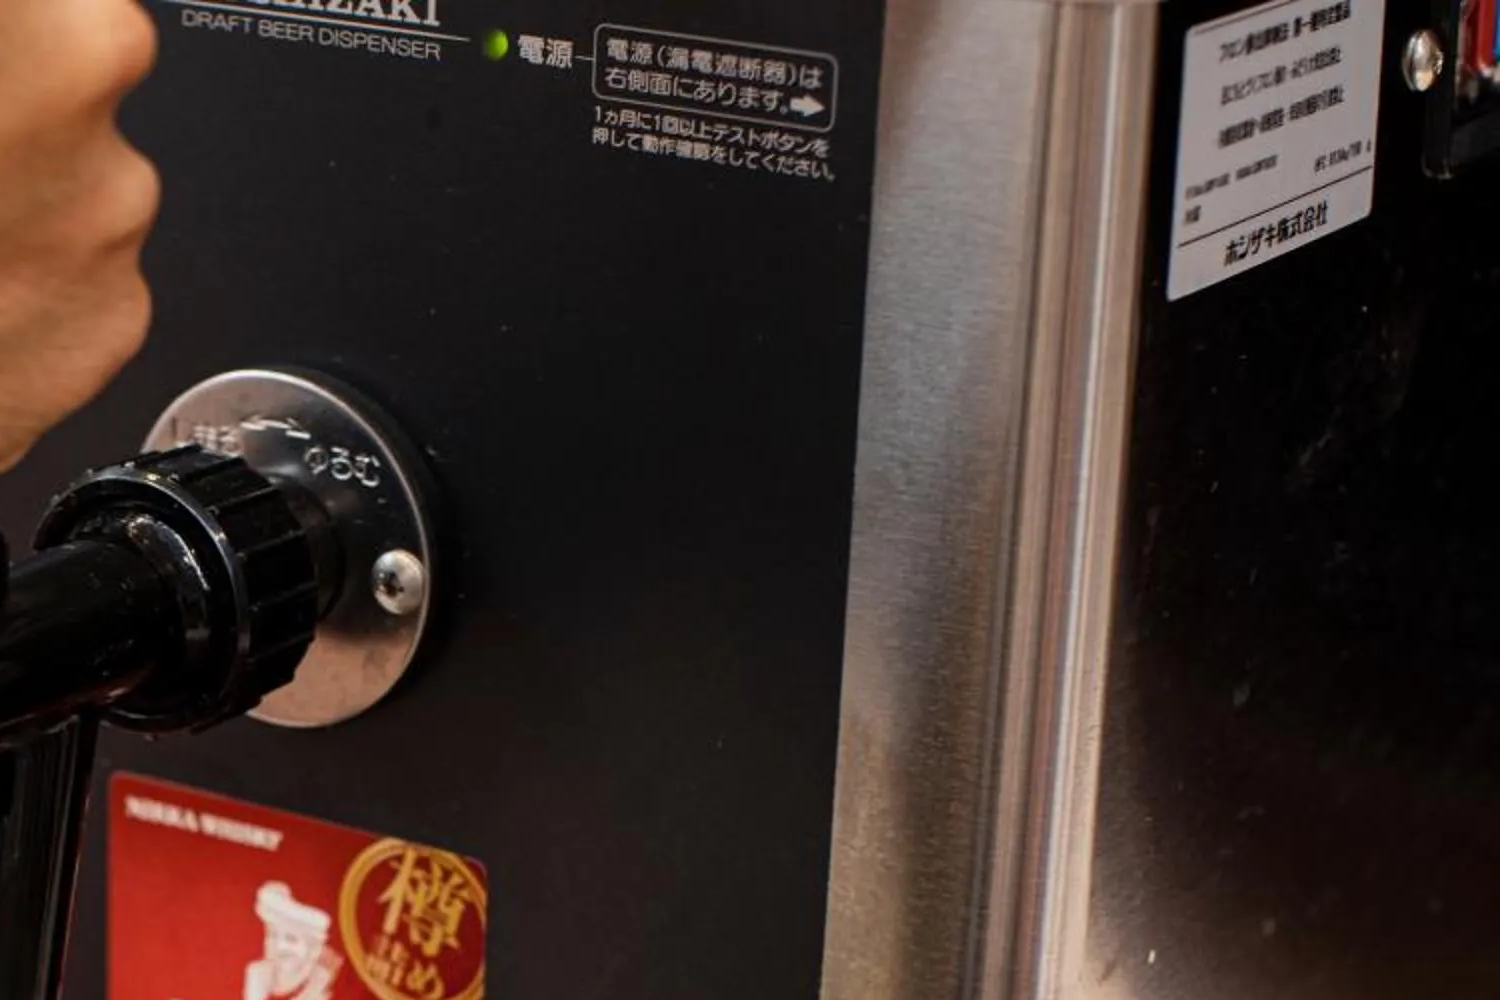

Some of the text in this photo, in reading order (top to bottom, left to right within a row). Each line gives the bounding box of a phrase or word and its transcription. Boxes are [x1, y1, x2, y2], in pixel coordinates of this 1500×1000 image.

[181, 8, 441, 61] DRAFT BEER DISPENSER
[517, 34, 575, 70] 電源
[604, 66, 790, 115] 右側面にあります。
[1223, 199, 1329, 267] ホシザキ株式会社
